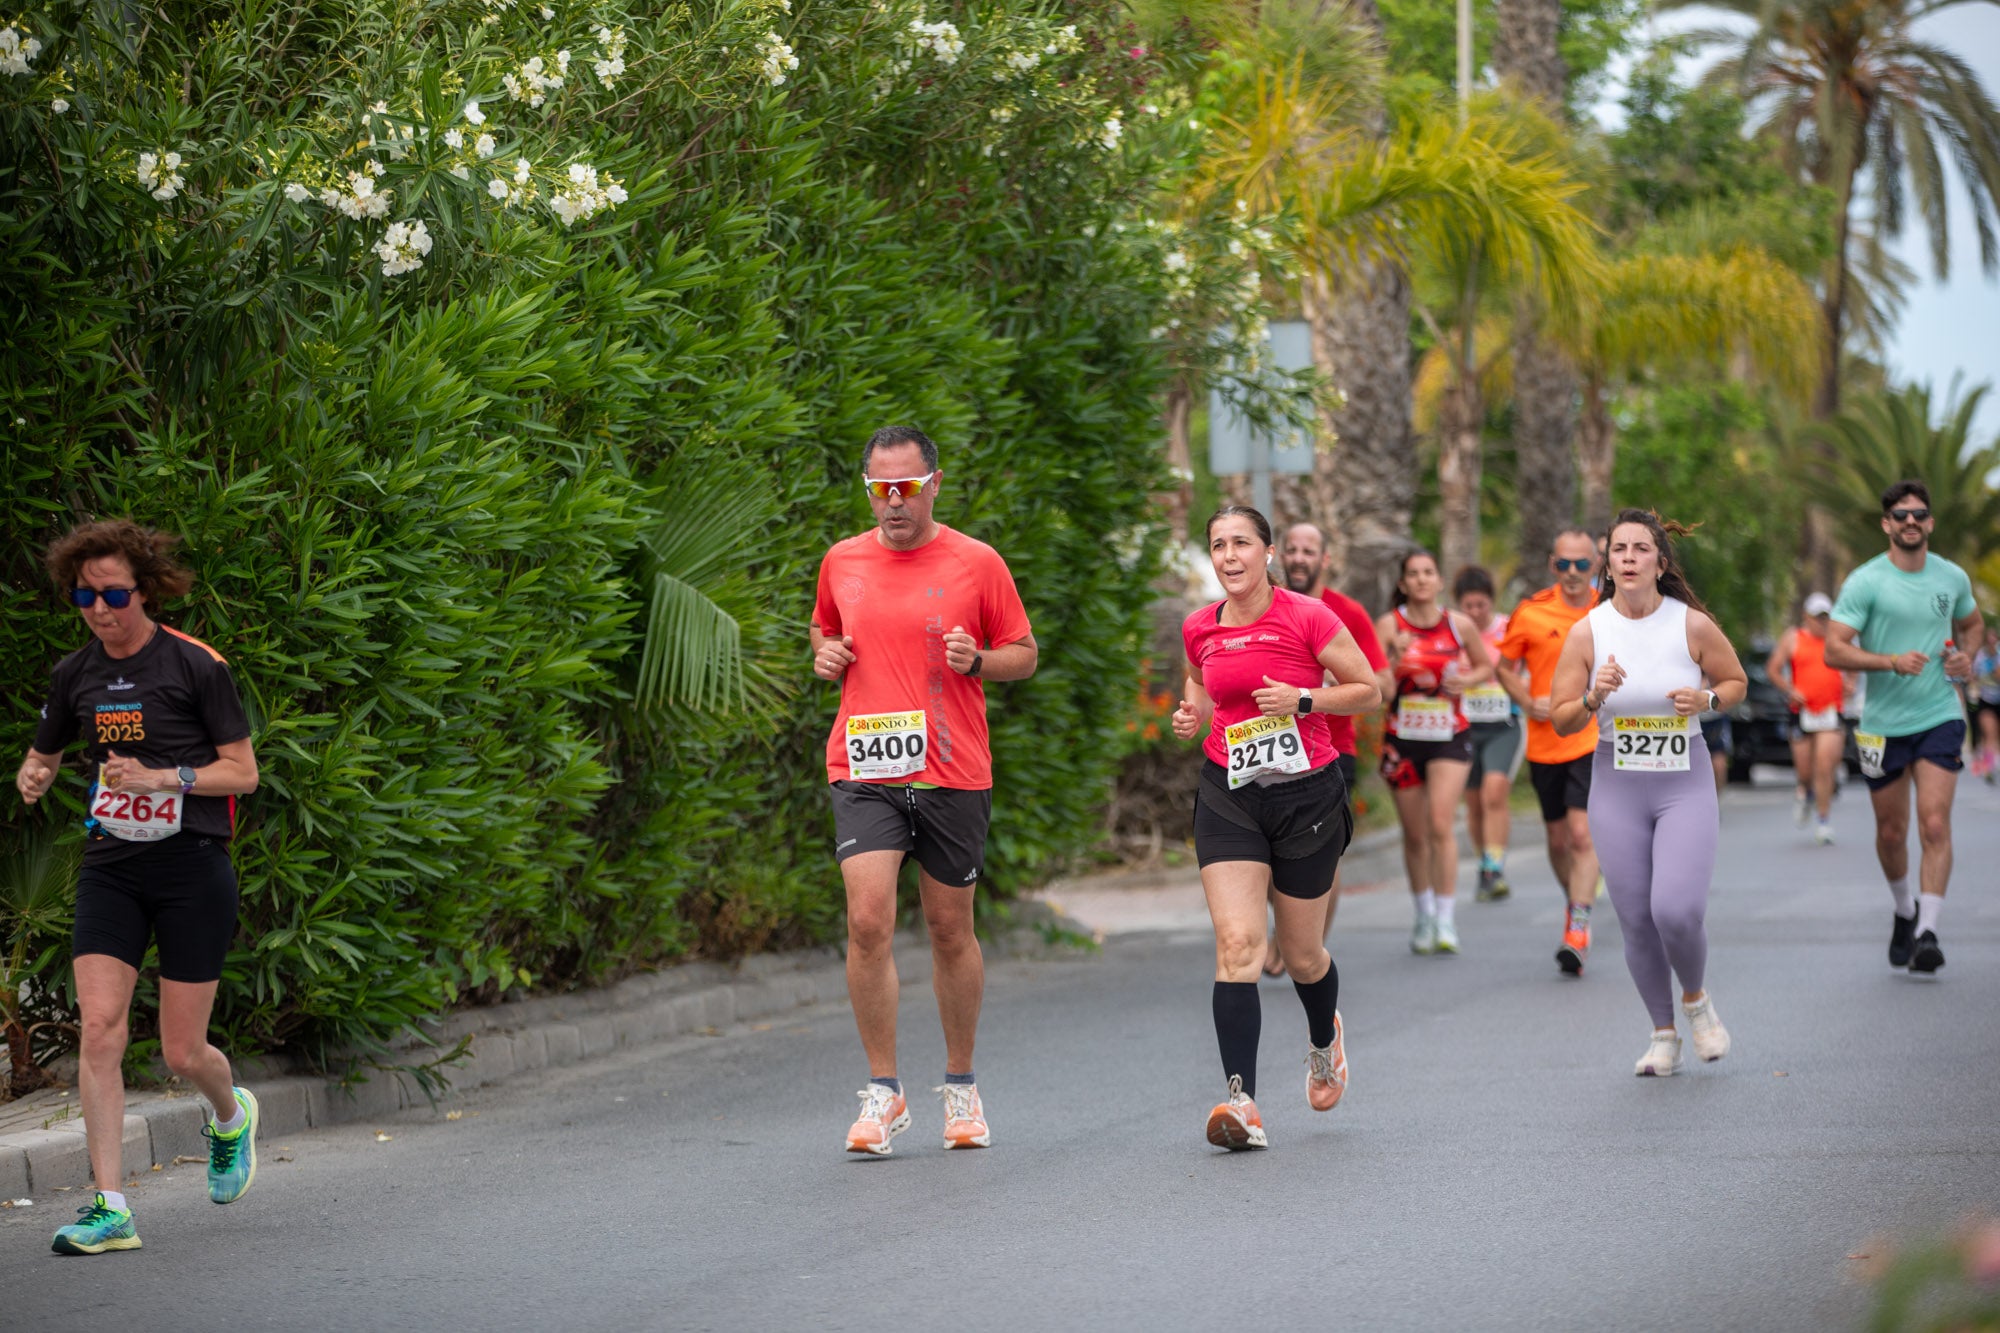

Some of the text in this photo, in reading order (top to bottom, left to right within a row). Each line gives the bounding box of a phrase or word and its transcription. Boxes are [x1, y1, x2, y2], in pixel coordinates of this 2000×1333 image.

[96, 703, 143, 713] GRAN PREMIO
[95, 711, 143, 725] FONDO
[856, 719, 867, 730] 38
[866, 719, 907, 730] FONDO
[1624, 718, 1637, 728] 38
[97, 723, 145, 743] 2025
[1233, 727, 1244, 739] 38
[849, 734, 924, 762] 3400
[1231, 732, 1299, 771] 3279
[1617, 734, 1686, 756] 3270
[94, 791, 177, 824] 2264
